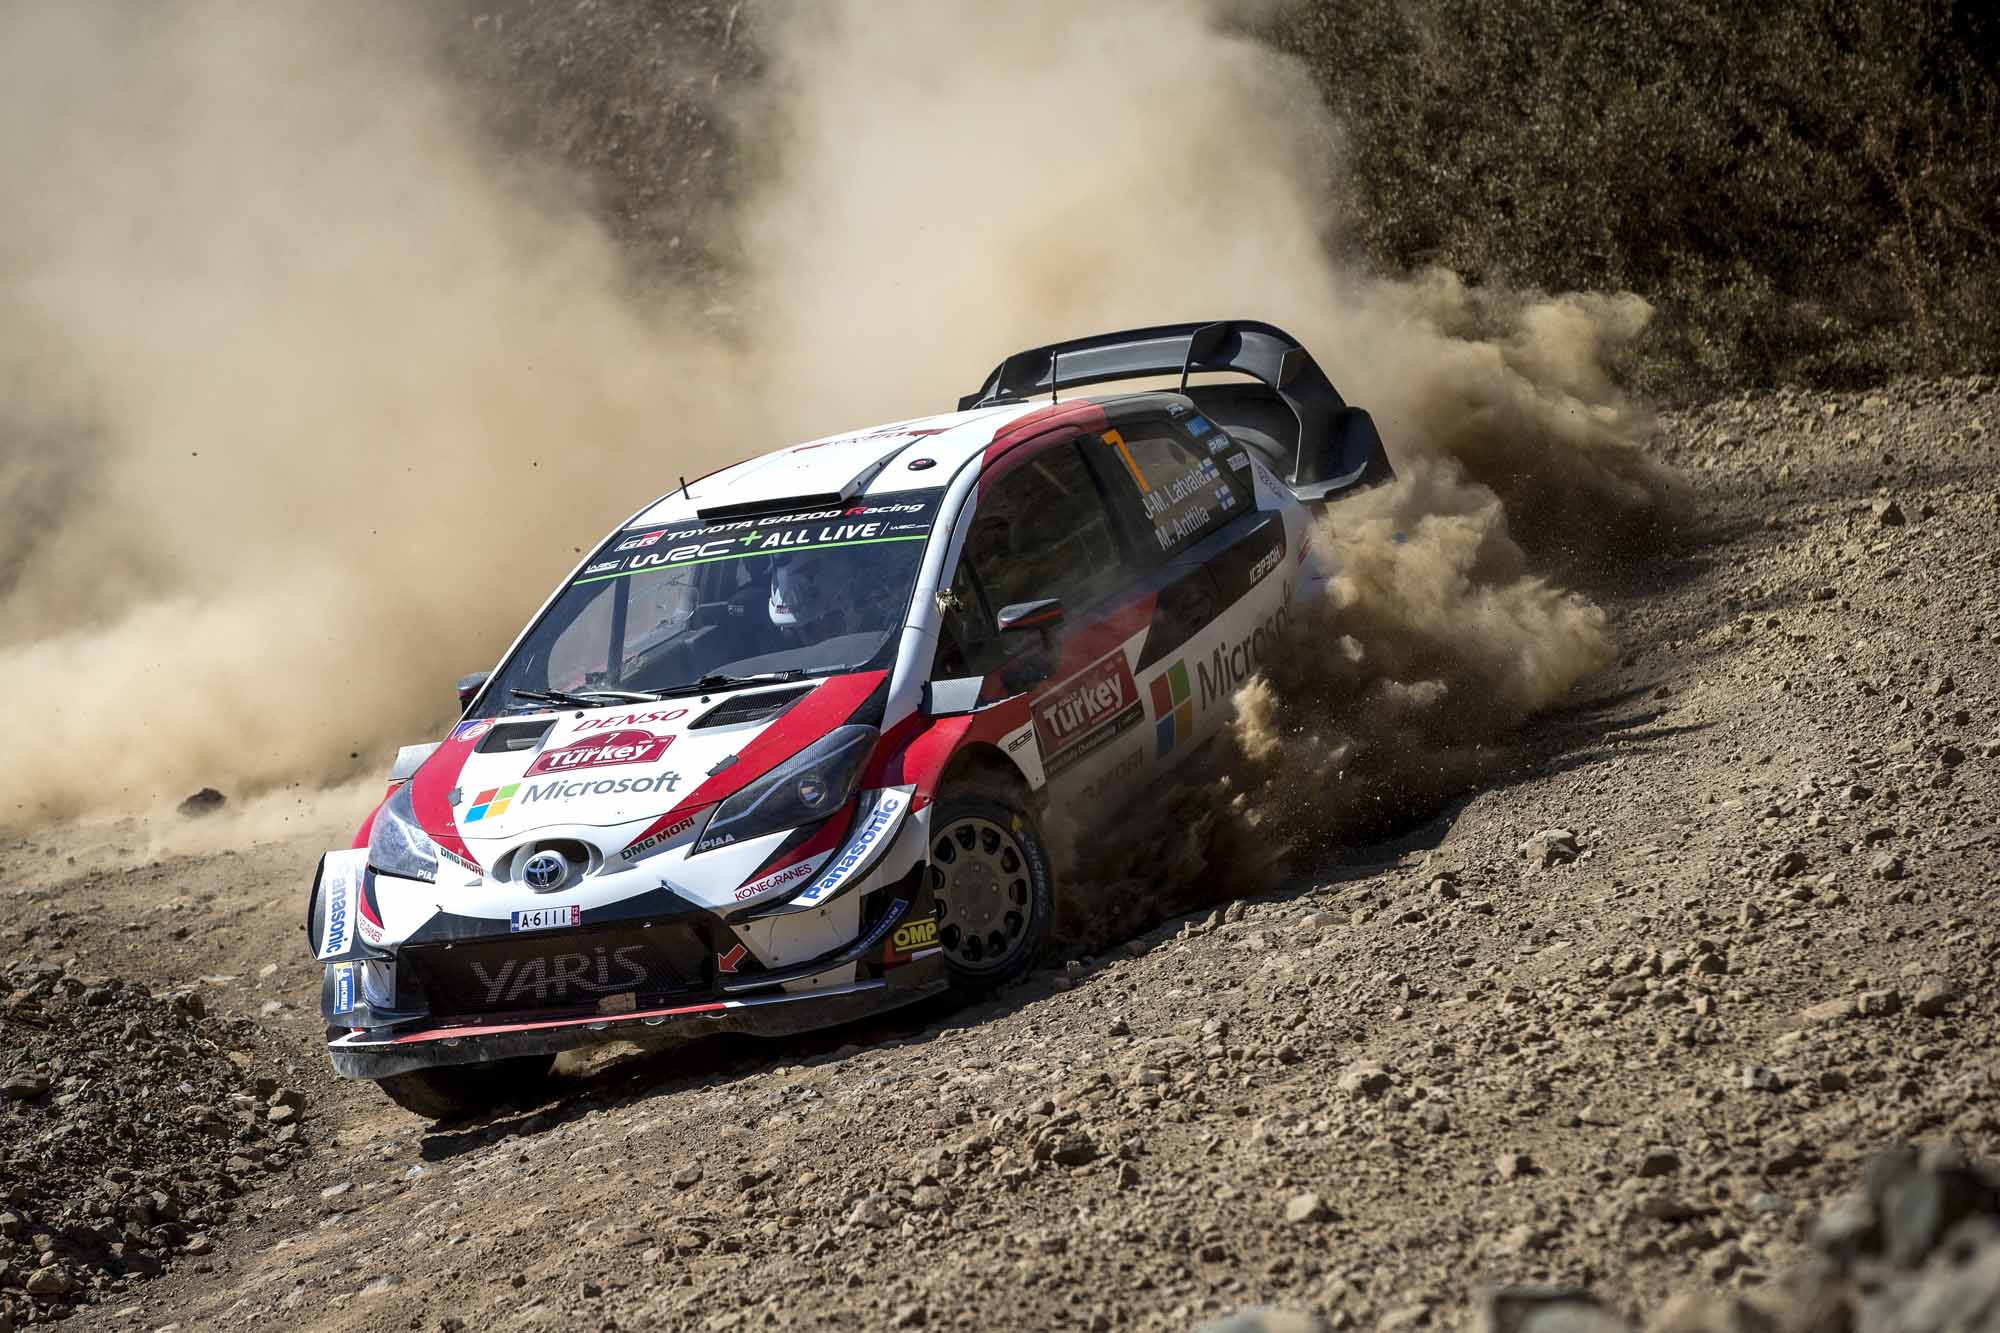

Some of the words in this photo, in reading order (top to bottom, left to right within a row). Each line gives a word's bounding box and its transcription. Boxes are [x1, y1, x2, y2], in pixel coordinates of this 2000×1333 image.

[1101, 429, 1150, 493] 7
[1163, 469, 1208, 504] Latvala
[667, 521, 753, 540] TOYOTA
[758, 509, 842, 526] GAZOO
[845, 503, 926, 516] Racing
[760, 530, 810, 548] ALL
[819, 522, 881, 542] LIVE
[1154, 526, 1176, 551] M.
[1172, 505, 1211, 540] Anttila
[573, 709, 689, 732] DENSO
[521, 771, 682, 805] Microsoft
[620, 839, 656, 861] DMG
[656, 817, 696, 845] MORI
[701, 833, 736, 850] PIAA
[801, 798, 900, 900] Panasonic
[460, 858, 485, 877] MORI
[735, 863, 813, 901] KONECRANES
[326, 867, 348, 954] anasonic
[893, 923, 938, 946] OMP
